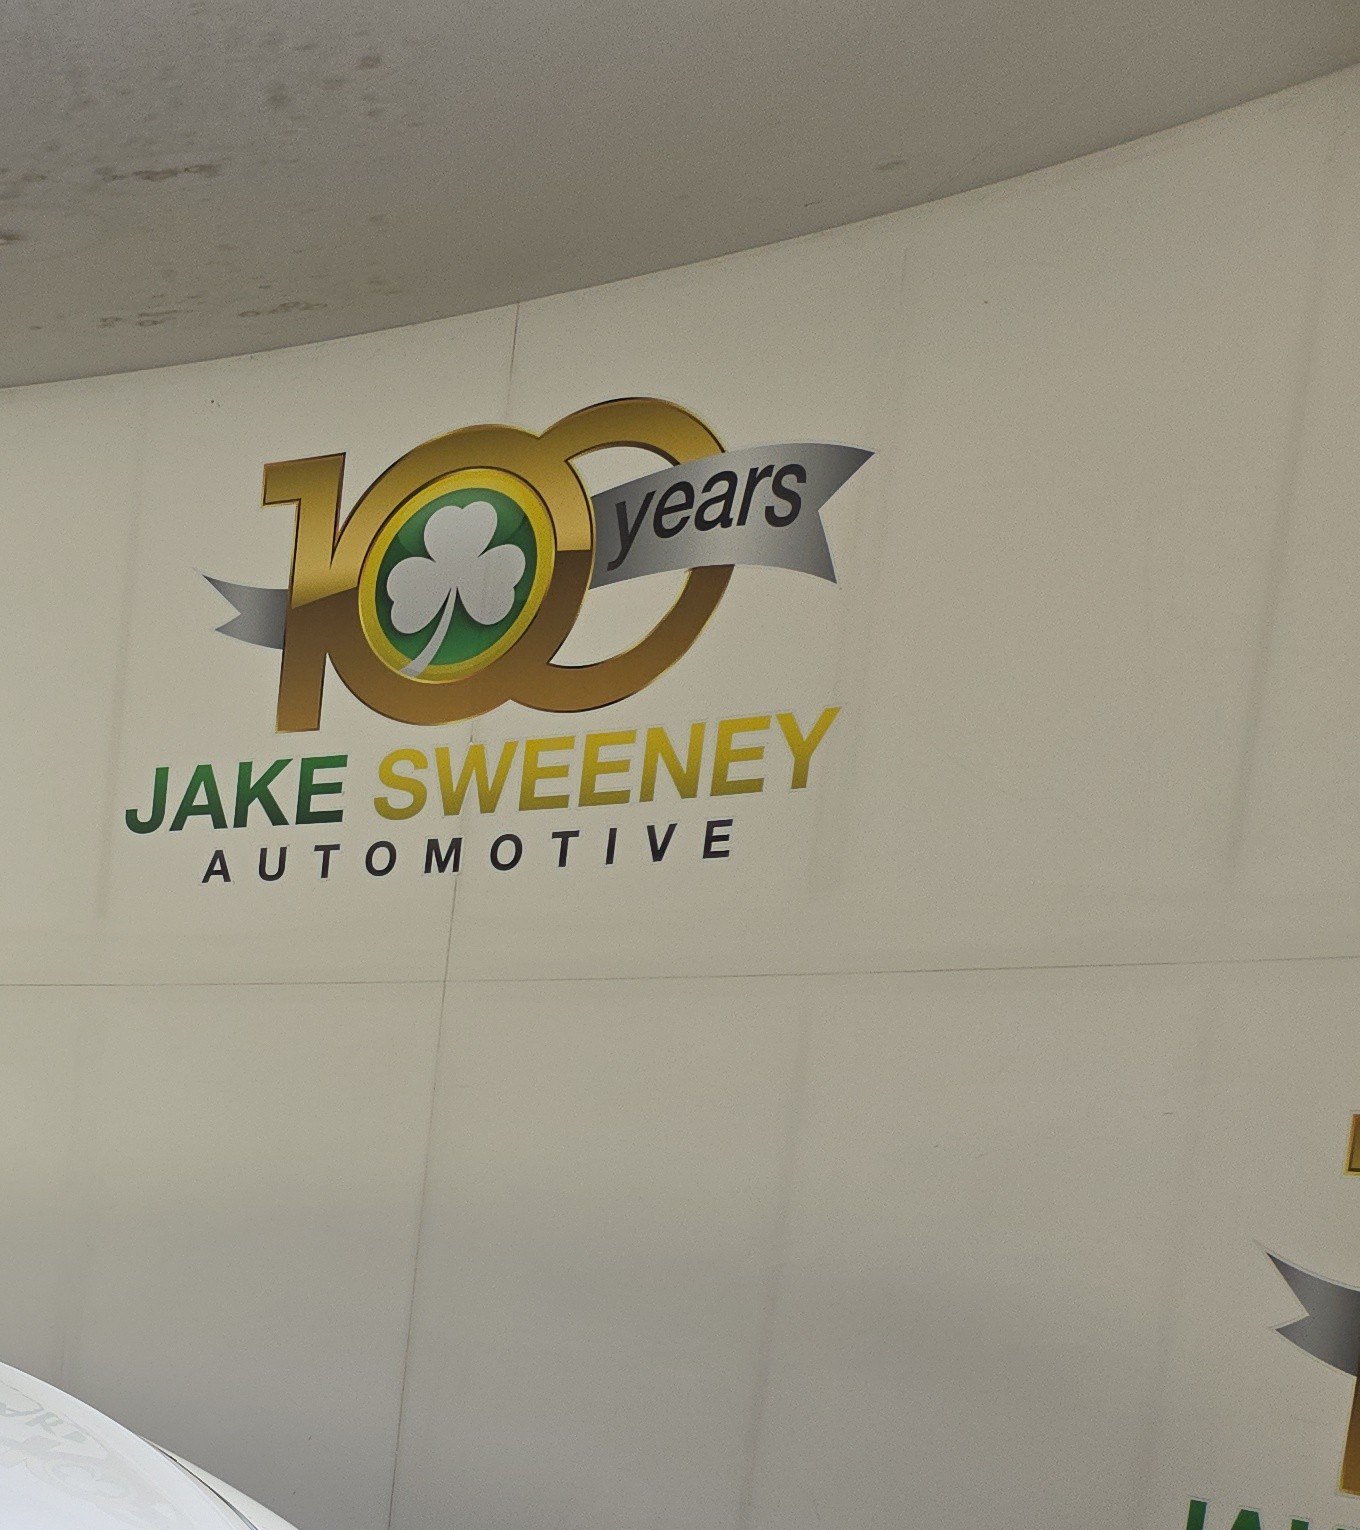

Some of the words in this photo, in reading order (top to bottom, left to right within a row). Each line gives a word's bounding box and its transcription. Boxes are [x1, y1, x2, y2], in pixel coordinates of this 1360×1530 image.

[605, 461, 807, 572] years
[125, 754, 349, 834] JAKE
[373, 706, 842, 821] SWEENEY
[202, 818, 734, 884] AUTOMOTIVE
